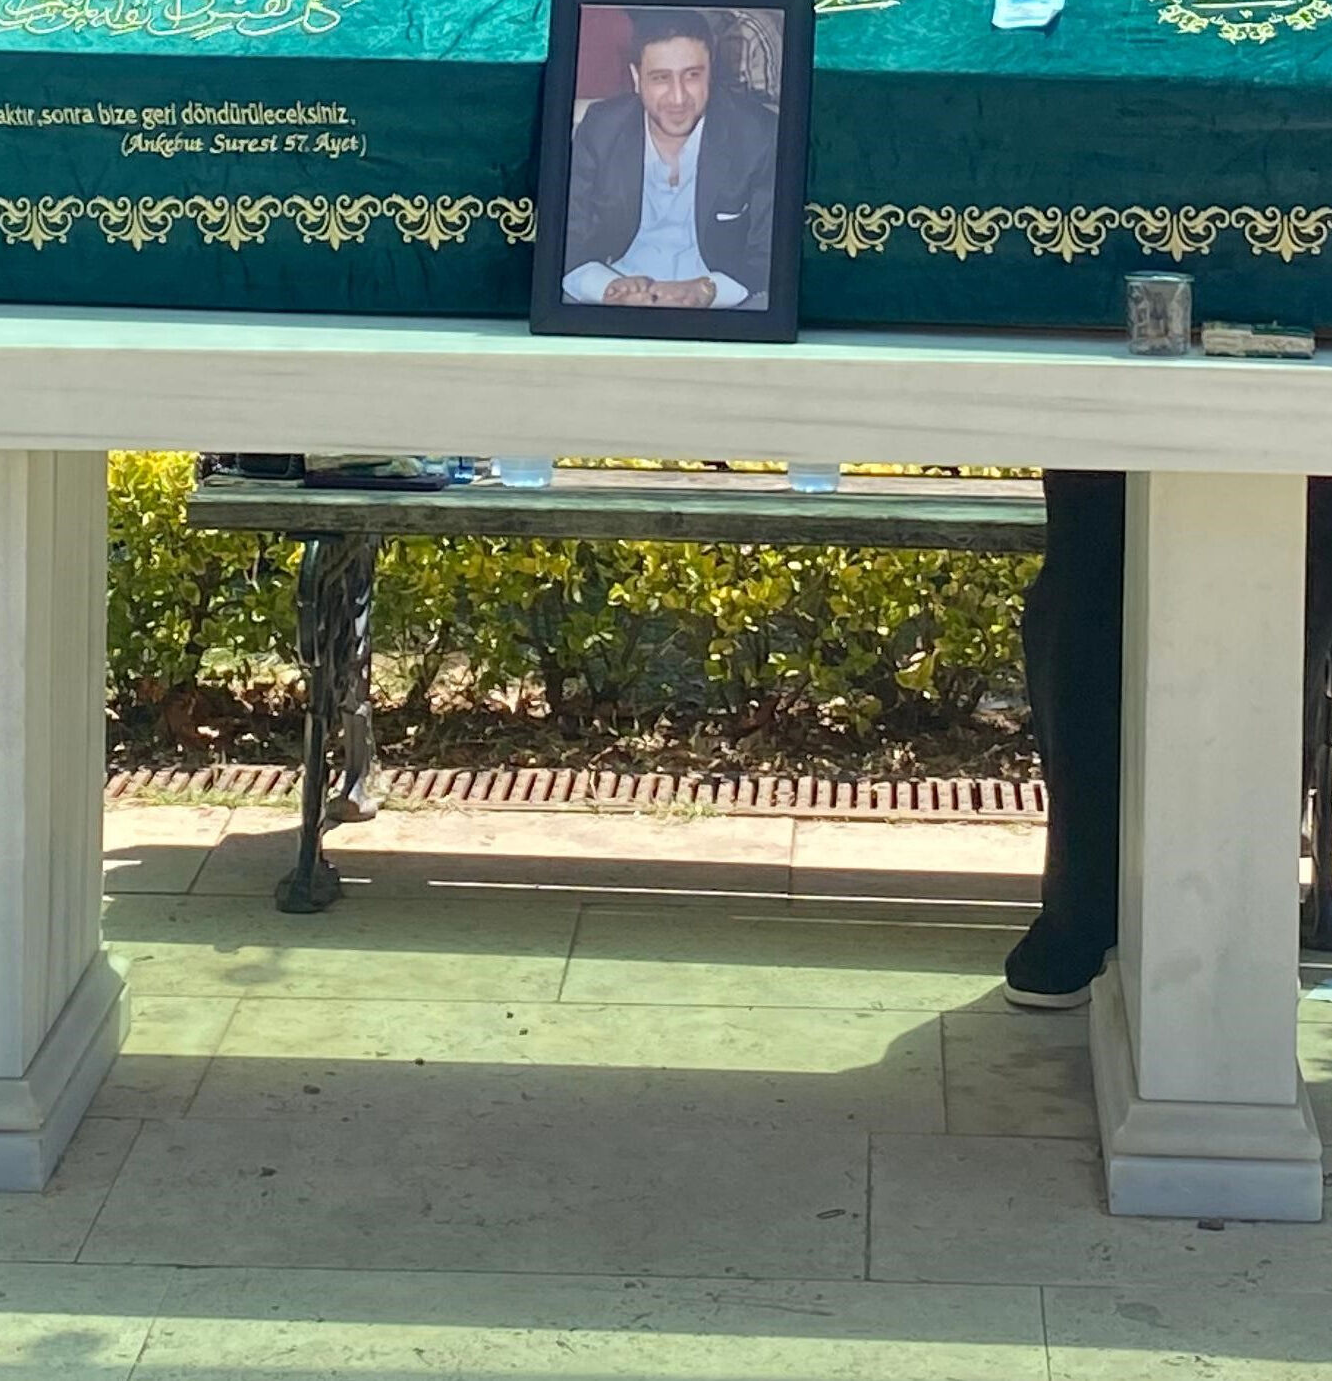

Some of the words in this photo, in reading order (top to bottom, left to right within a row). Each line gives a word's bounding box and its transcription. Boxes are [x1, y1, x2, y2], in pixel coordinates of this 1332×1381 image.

[97, 101, 137, 125] bize
[141, 103, 177, 130] geri
[209, 133, 278, 154] Suresi
